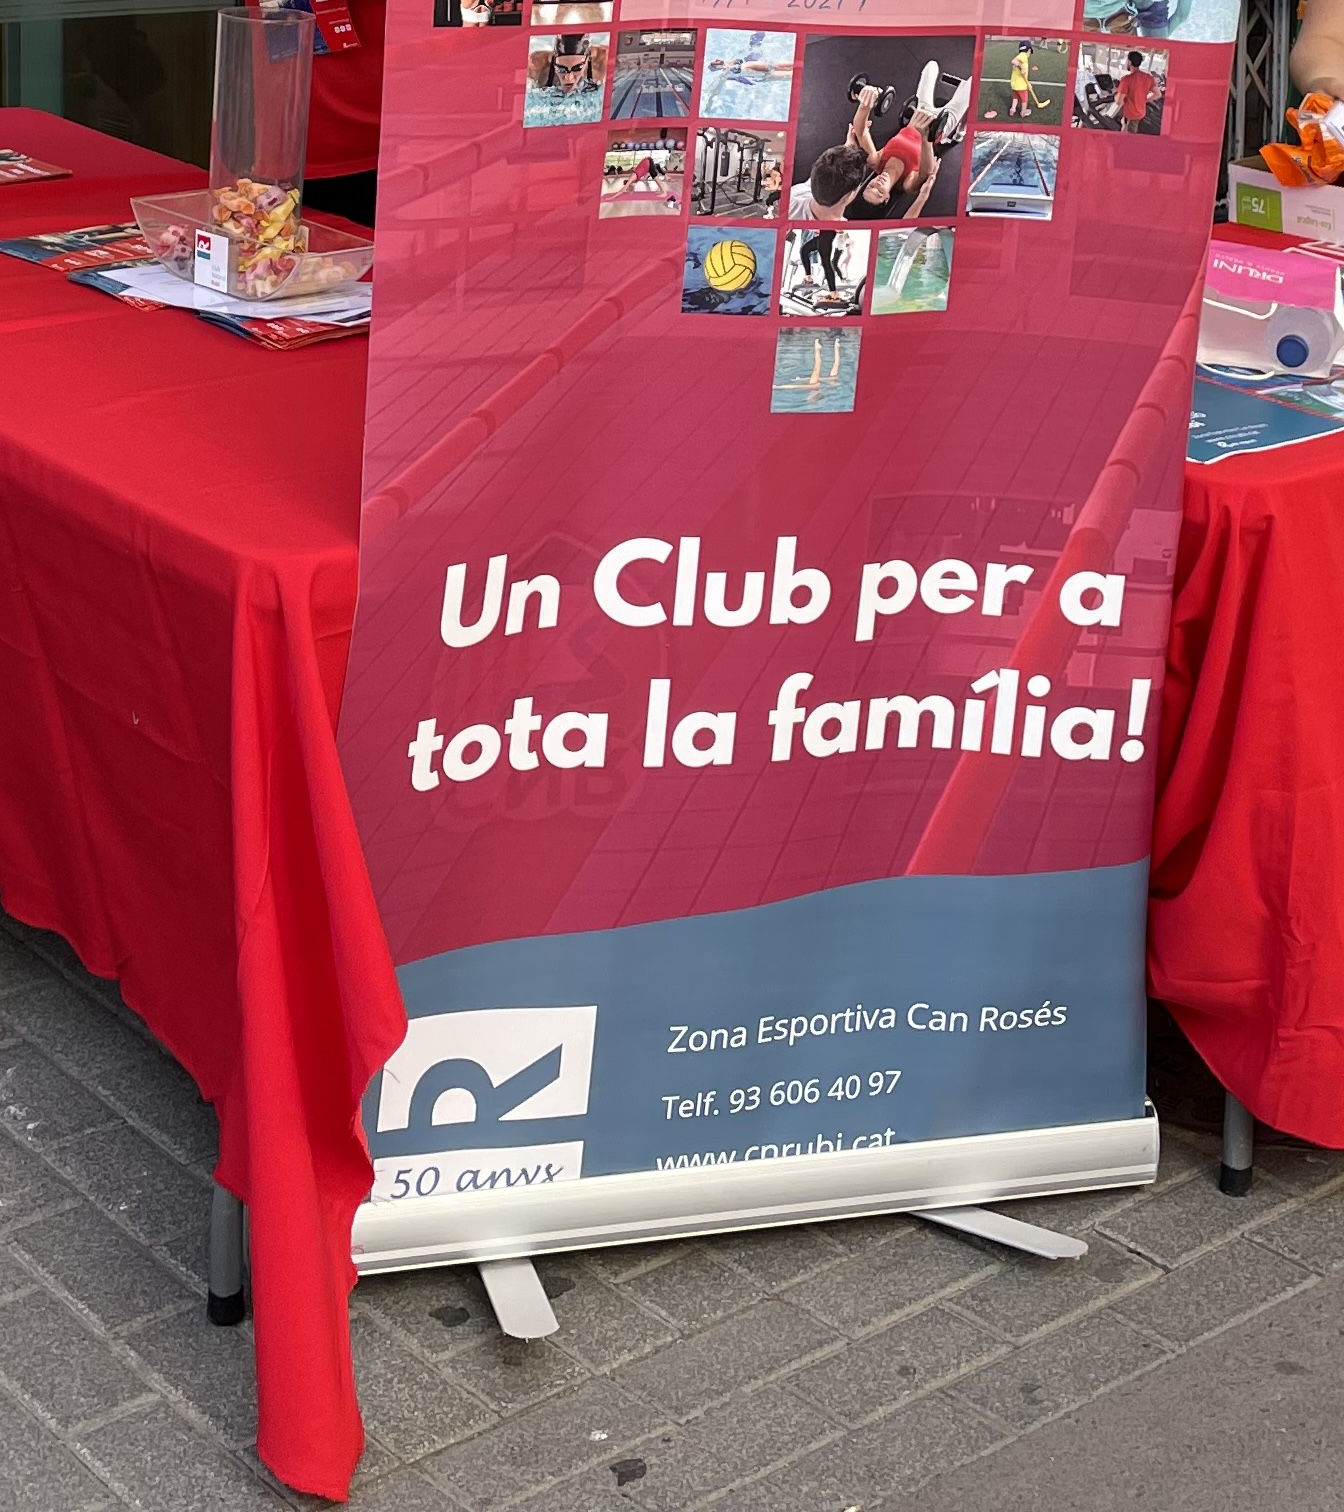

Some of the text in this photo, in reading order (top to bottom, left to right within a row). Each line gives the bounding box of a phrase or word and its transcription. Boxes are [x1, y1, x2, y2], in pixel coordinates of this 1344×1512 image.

[439, 535, 1126, 648] Un Club per a
[408, 668, 1152, 793] tota la família!
[667, 1001, 1068, 1055] Zona Esportiva Can Rosés
[662, 1070, 902, 1121] Telf. 93 606 40 97
[656, 1127, 897, 1171] wwwcnrubicat
[390, 1165, 441, 1201] 50
